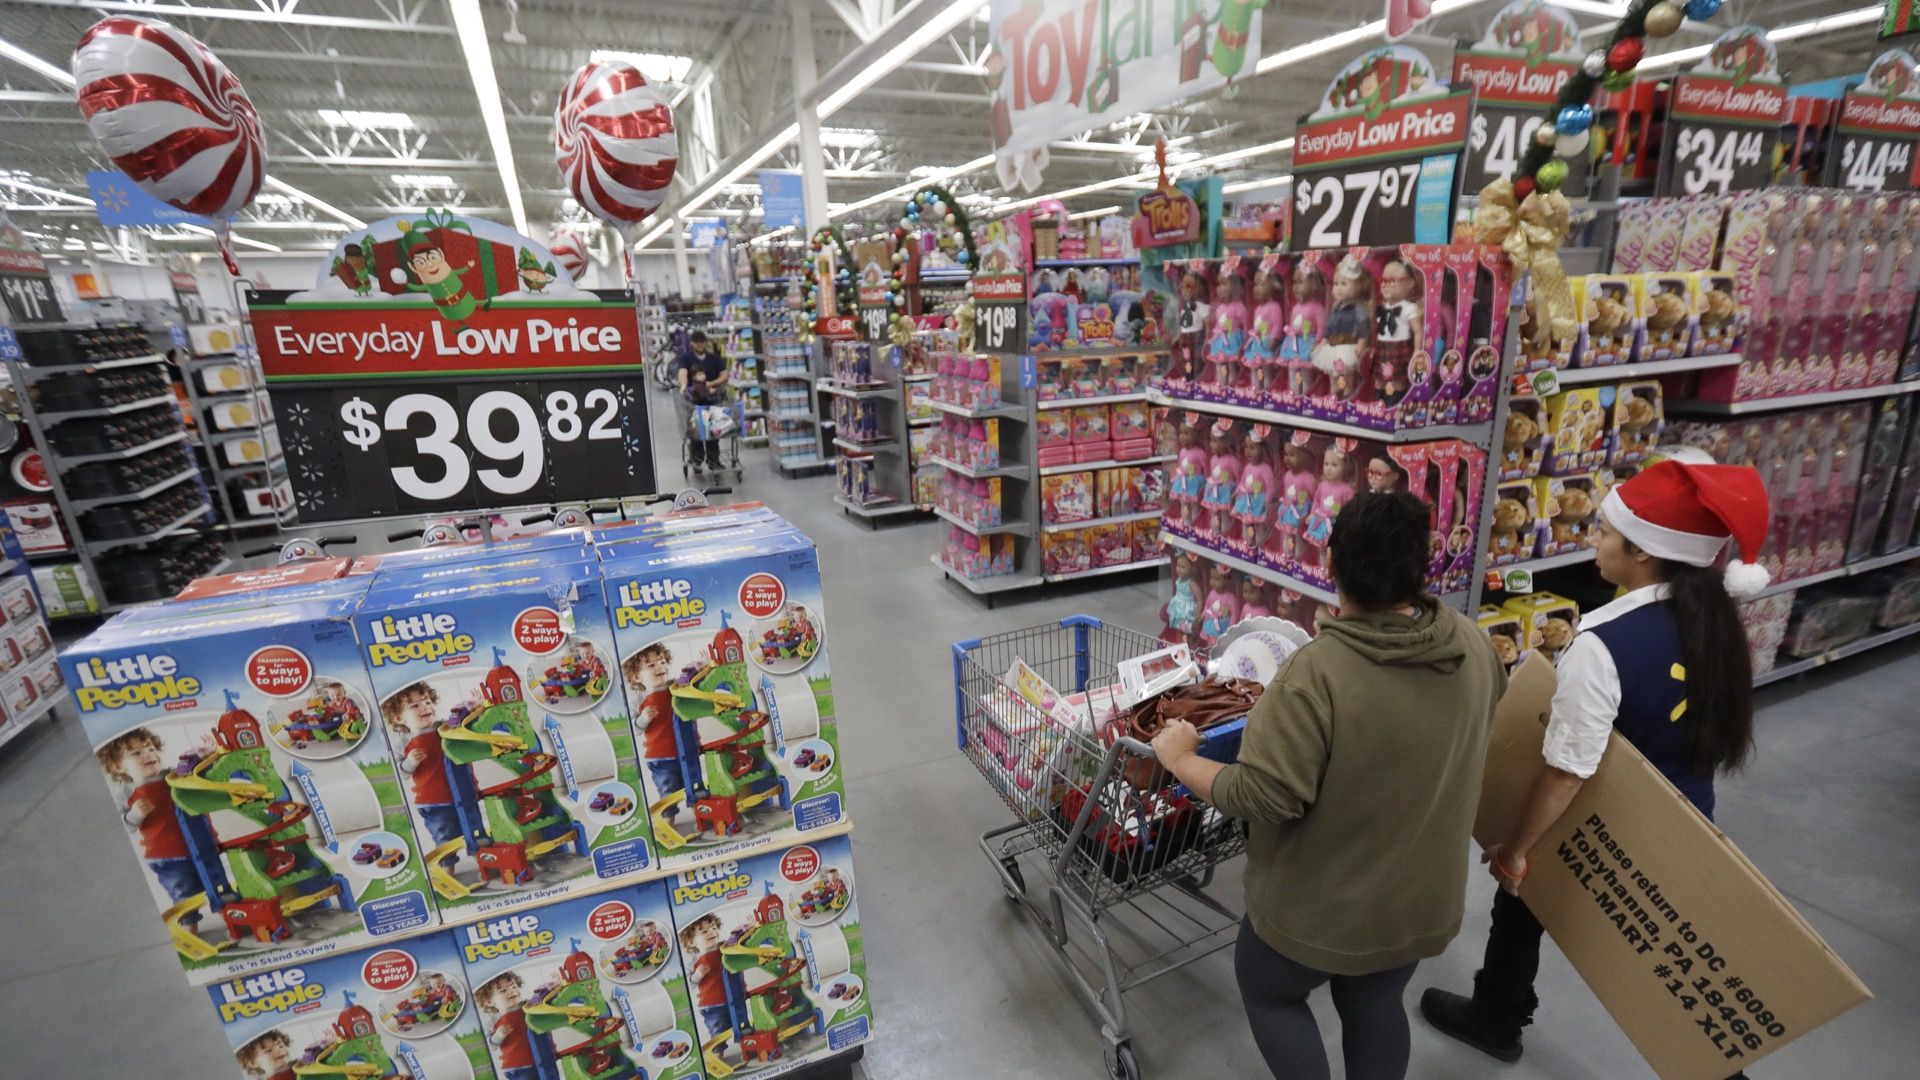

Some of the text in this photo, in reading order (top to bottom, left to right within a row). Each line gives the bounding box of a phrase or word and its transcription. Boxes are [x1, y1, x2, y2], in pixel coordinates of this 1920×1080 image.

[1517, 66, 1553, 91] Low
[1679, 83, 1783, 116] Everyday Low Price
[1847, 100, 1879, 123] Everyday
[1877, 105, 1900, 125] Low
[1299, 109, 1456, 156] Everyday Low Price
[993, 281, 1008, 293] Low
[274, 317, 622, 361] Everyday Low Price
[619, 579, 690, 606] Little
[746, 590, 777, 601] 2 ways
[755, 599, 778, 609] play!
[616, 598, 705, 628] People
[371, 613, 456, 644] Little
[531, 626, 559, 636] ways
[533, 635, 560, 646] play!
[368, 633, 474, 666] People
[76, 653, 177, 688] Little
[256, 675, 303, 686] to play!
[257, 666, 301, 677] 2 ways
[75, 675, 200, 712] People
[300, 774, 314, 797] Over
[602, 843, 636, 856] Discover:
[691, 853, 703, 862] Sit
[714, 844, 740, 857] Stand
[740, 835, 772, 850] Skyway
[621, 862, 645, 874] YEARS
[677, 860, 739, 887] Little
[786, 860, 813, 870] 2 ways
[795, 866, 814, 877] play!
[476, 902, 493, 913] Sit
[503, 894, 533, 907] Stand
[534, 884, 570, 899] Skyway
[674, 873, 751, 905] People
[371, 897, 412, 912] Discover:
[395, 917, 424, 931] YEARS
[466, 914, 540, 945] Little
[593, 922, 627, 933] to play!
[594, 915, 626, 926] 2 ways
[1585, 813, 1785, 1037] Please return to DC #6080
[464, 930, 554, 963] People
[1556, 840, 1745, 1060] WAL-MART #14 XLT
[1570, 827, 1763, 1050] Tobyhanna, PA 18466
[228, 963, 246, 974] Sit
[260, 951, 294, 967] Stand
[295, 941, 337, 958] Skyway
[371, 965, 408, 976] 2 ways
[221, 967, 306, 1003] Little
[370, 973, 409, 985] to play!
[219, 983, 325, 1023] People
[758, 1057, 808, 1080] Stand Skyway
